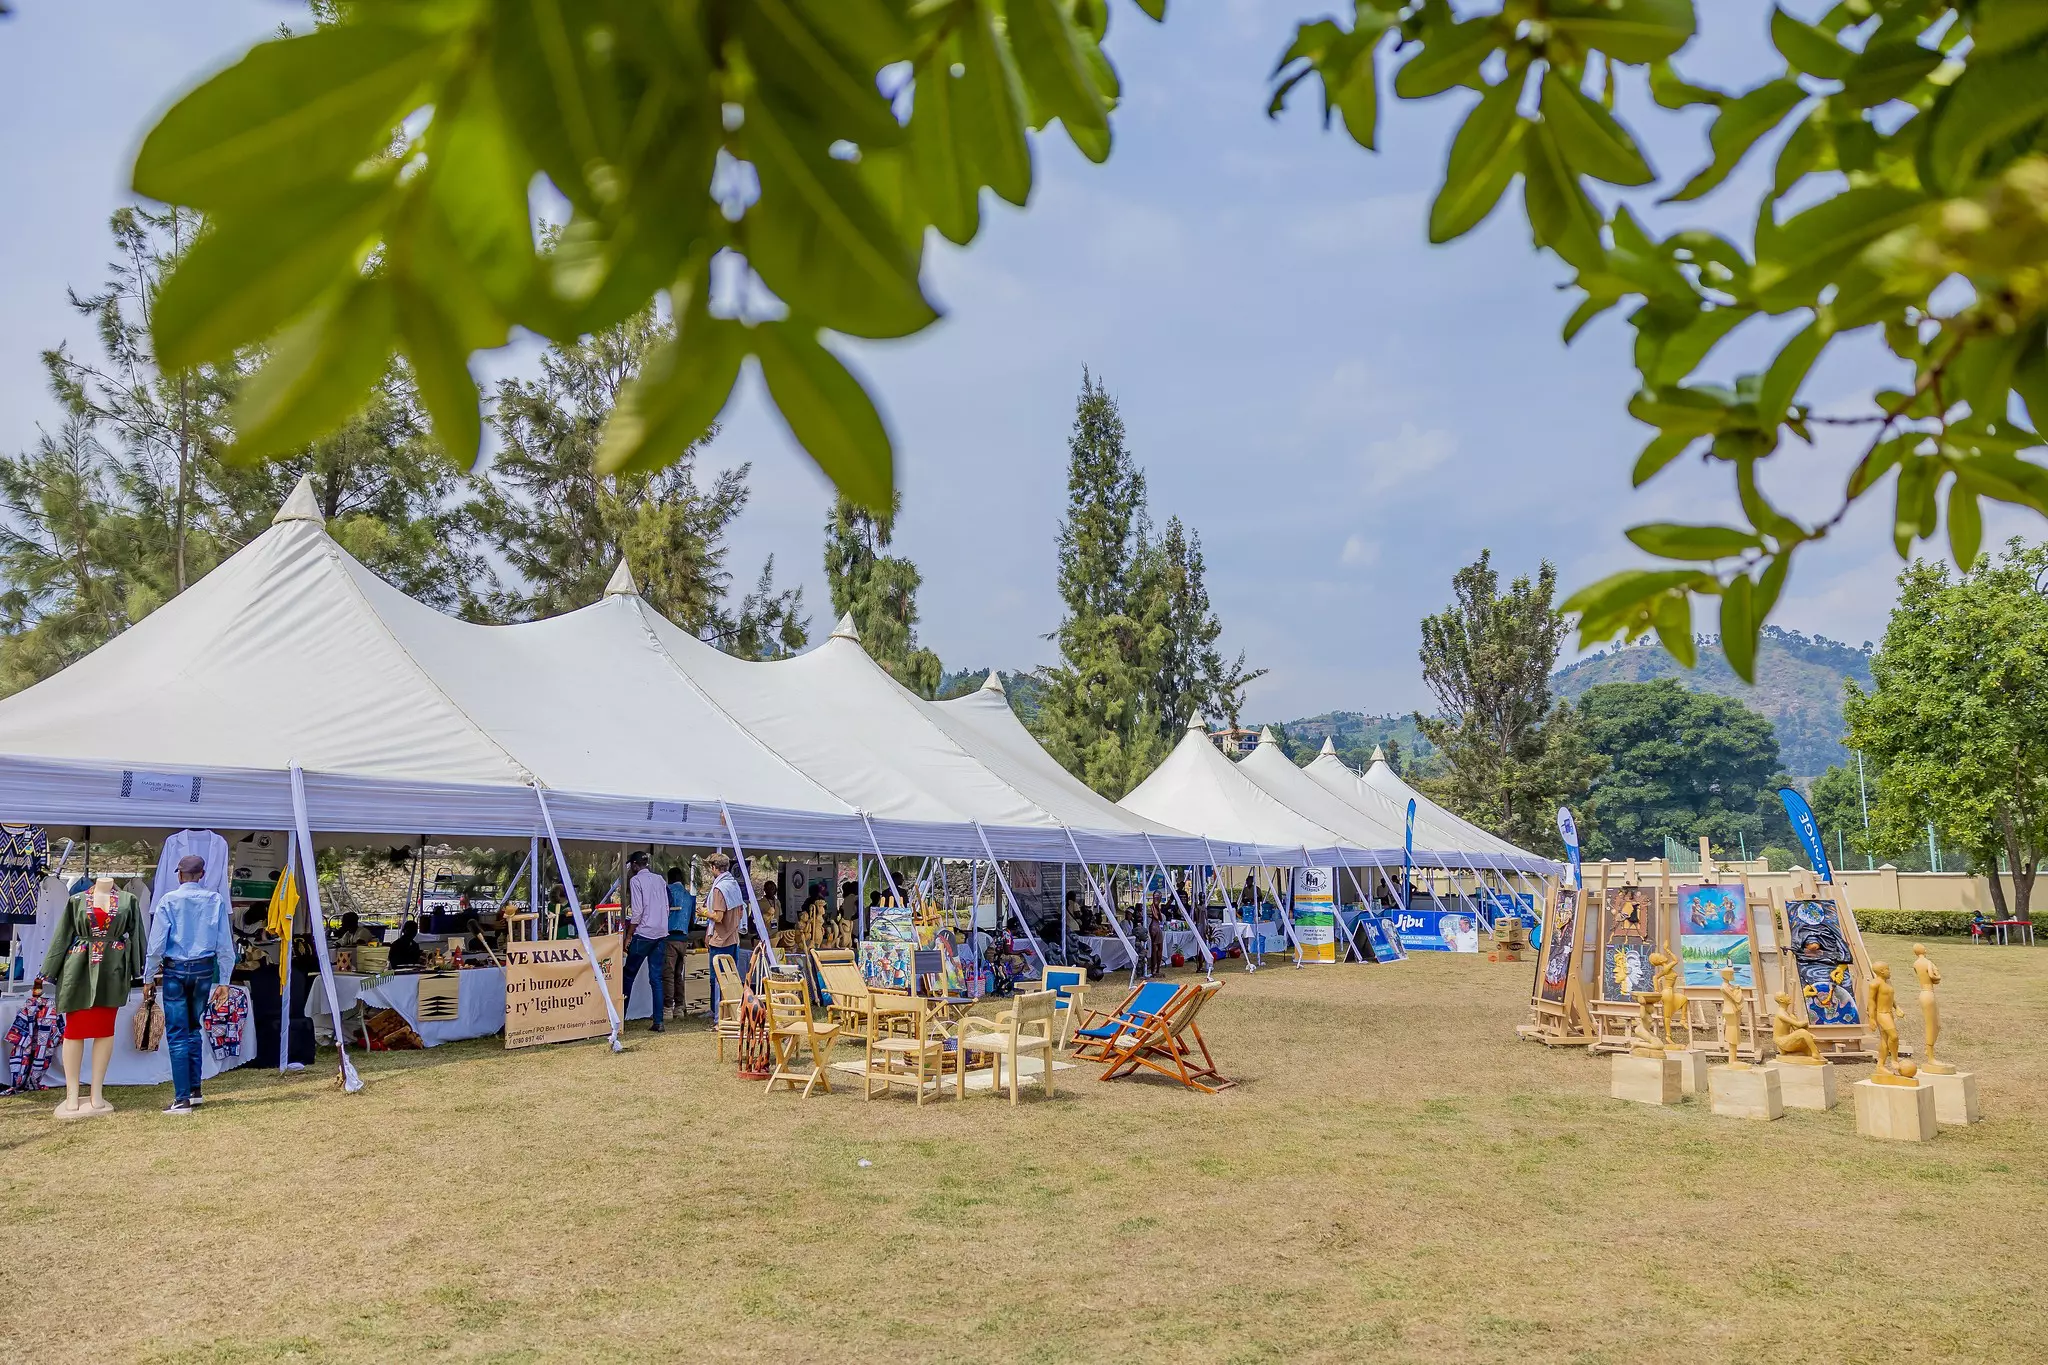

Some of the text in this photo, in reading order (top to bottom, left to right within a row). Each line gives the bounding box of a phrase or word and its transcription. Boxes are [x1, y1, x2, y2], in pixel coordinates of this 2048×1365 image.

[1396, 914, 1424, 932] Jibu
[532, 948, 584, 964] KIAKA
[530, 978, 574, 991] bunoze
